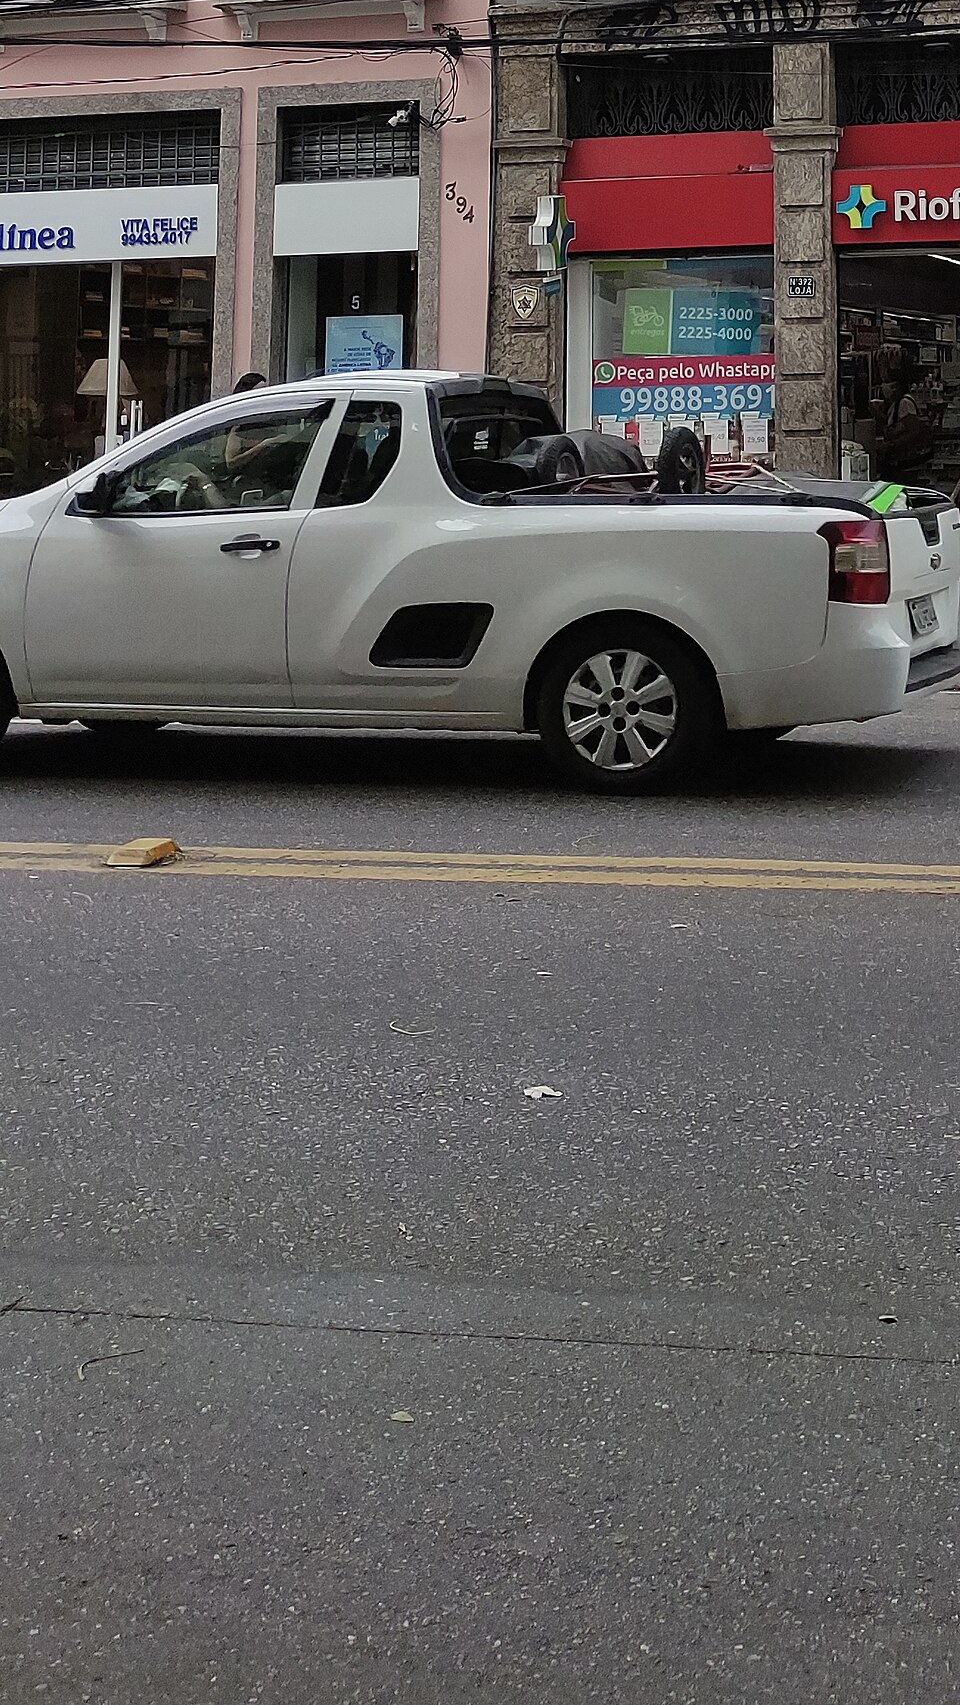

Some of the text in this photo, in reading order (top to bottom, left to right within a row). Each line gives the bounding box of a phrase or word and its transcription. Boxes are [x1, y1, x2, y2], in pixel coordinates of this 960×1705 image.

[445, 181, 475, 224] 394
[121, 217, 198, 233] VITA FELICE
[789, 286, 812, 295] LOJA
[351, 295, 360, 310] 5
[679, 306, 754, 321] 2225-3000
[630, 328, 665, 337] entregas
[678, 326, 753, 341] 2225-4000
[617, 365, 654, 383] Peça
[659, 362, 695, 382] pelo
[620, 384, 776, 413] 99888-3691
